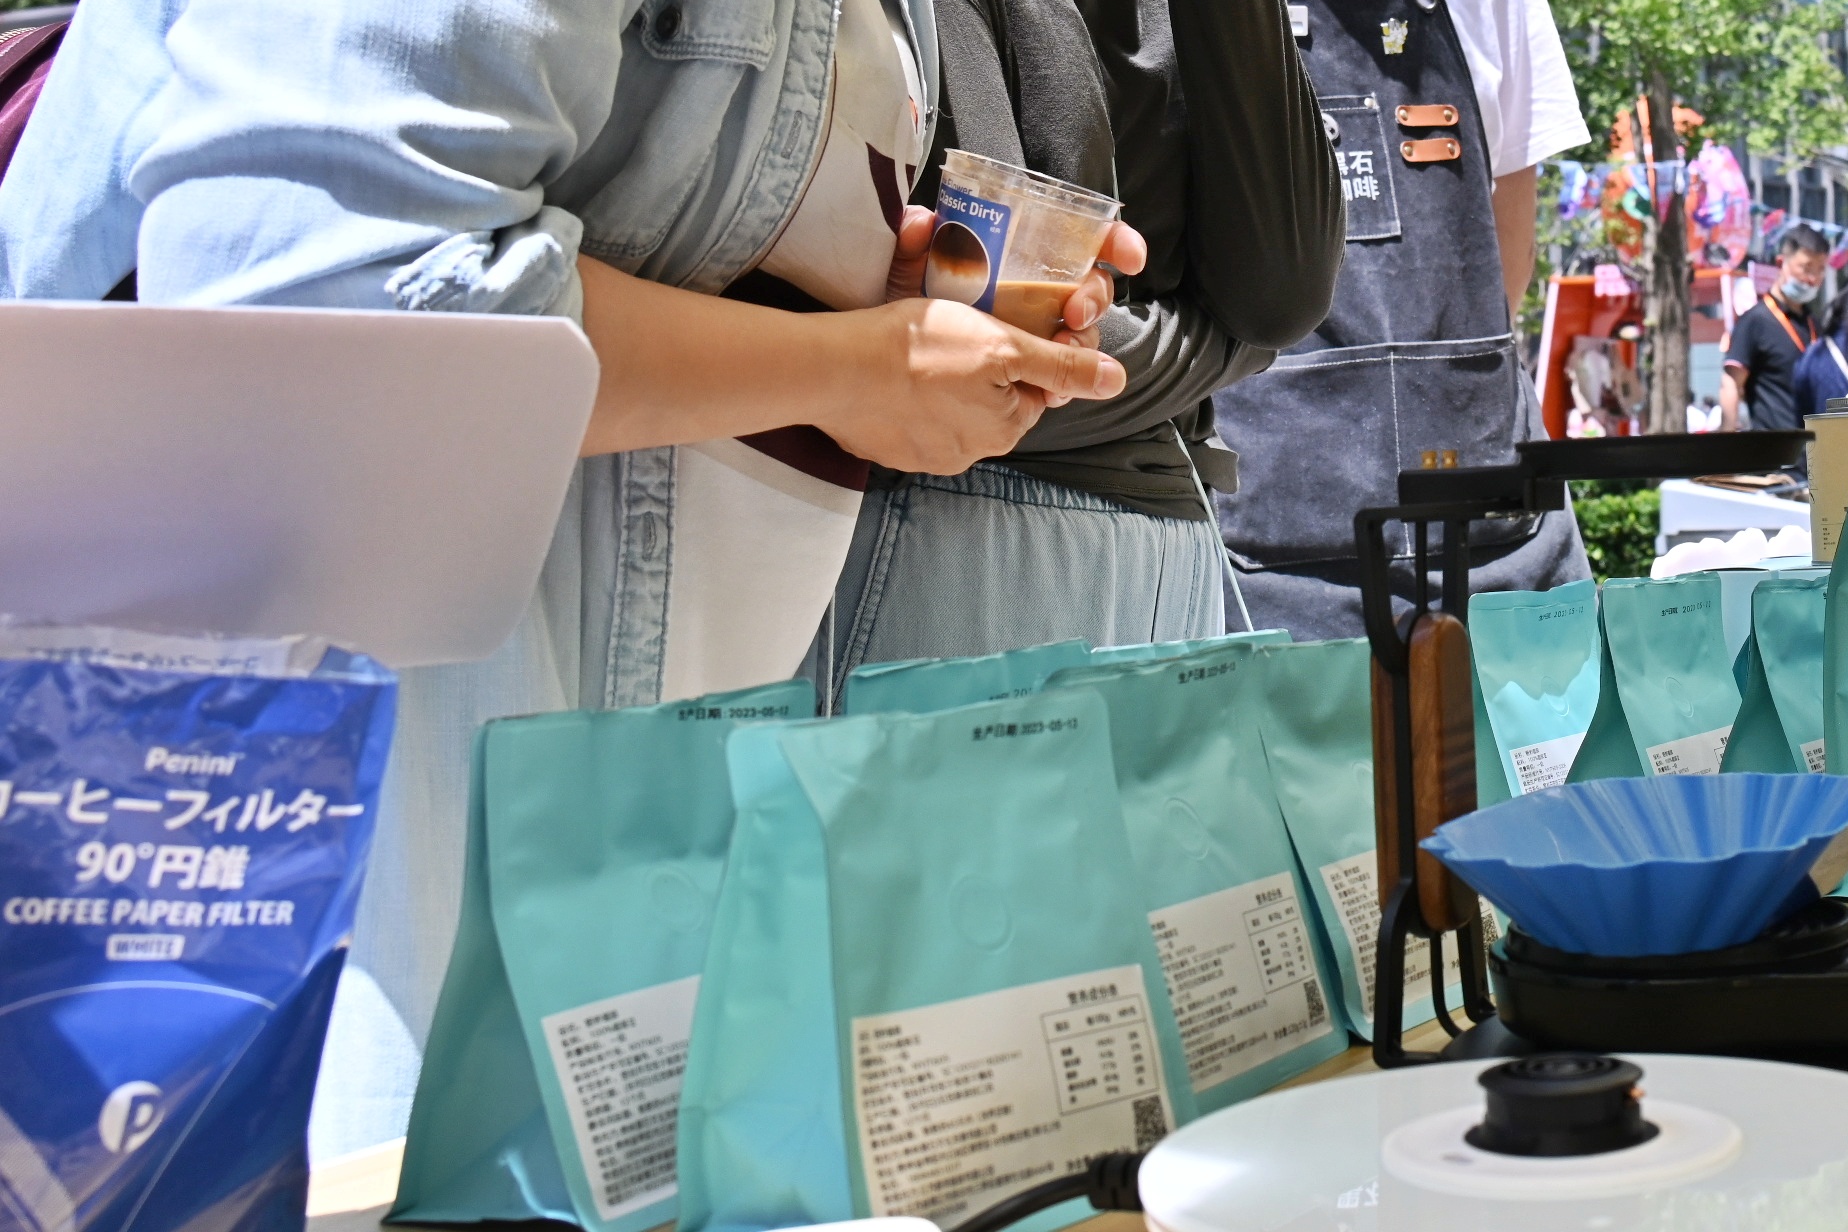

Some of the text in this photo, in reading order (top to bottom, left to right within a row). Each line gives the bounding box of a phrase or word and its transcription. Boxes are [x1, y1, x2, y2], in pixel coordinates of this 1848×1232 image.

[968, 201, 1004, 225] Dirty
[145, 747, 238, 776] Penini
[4, 896, 296, 928] COFFEE PAPER FILTER
